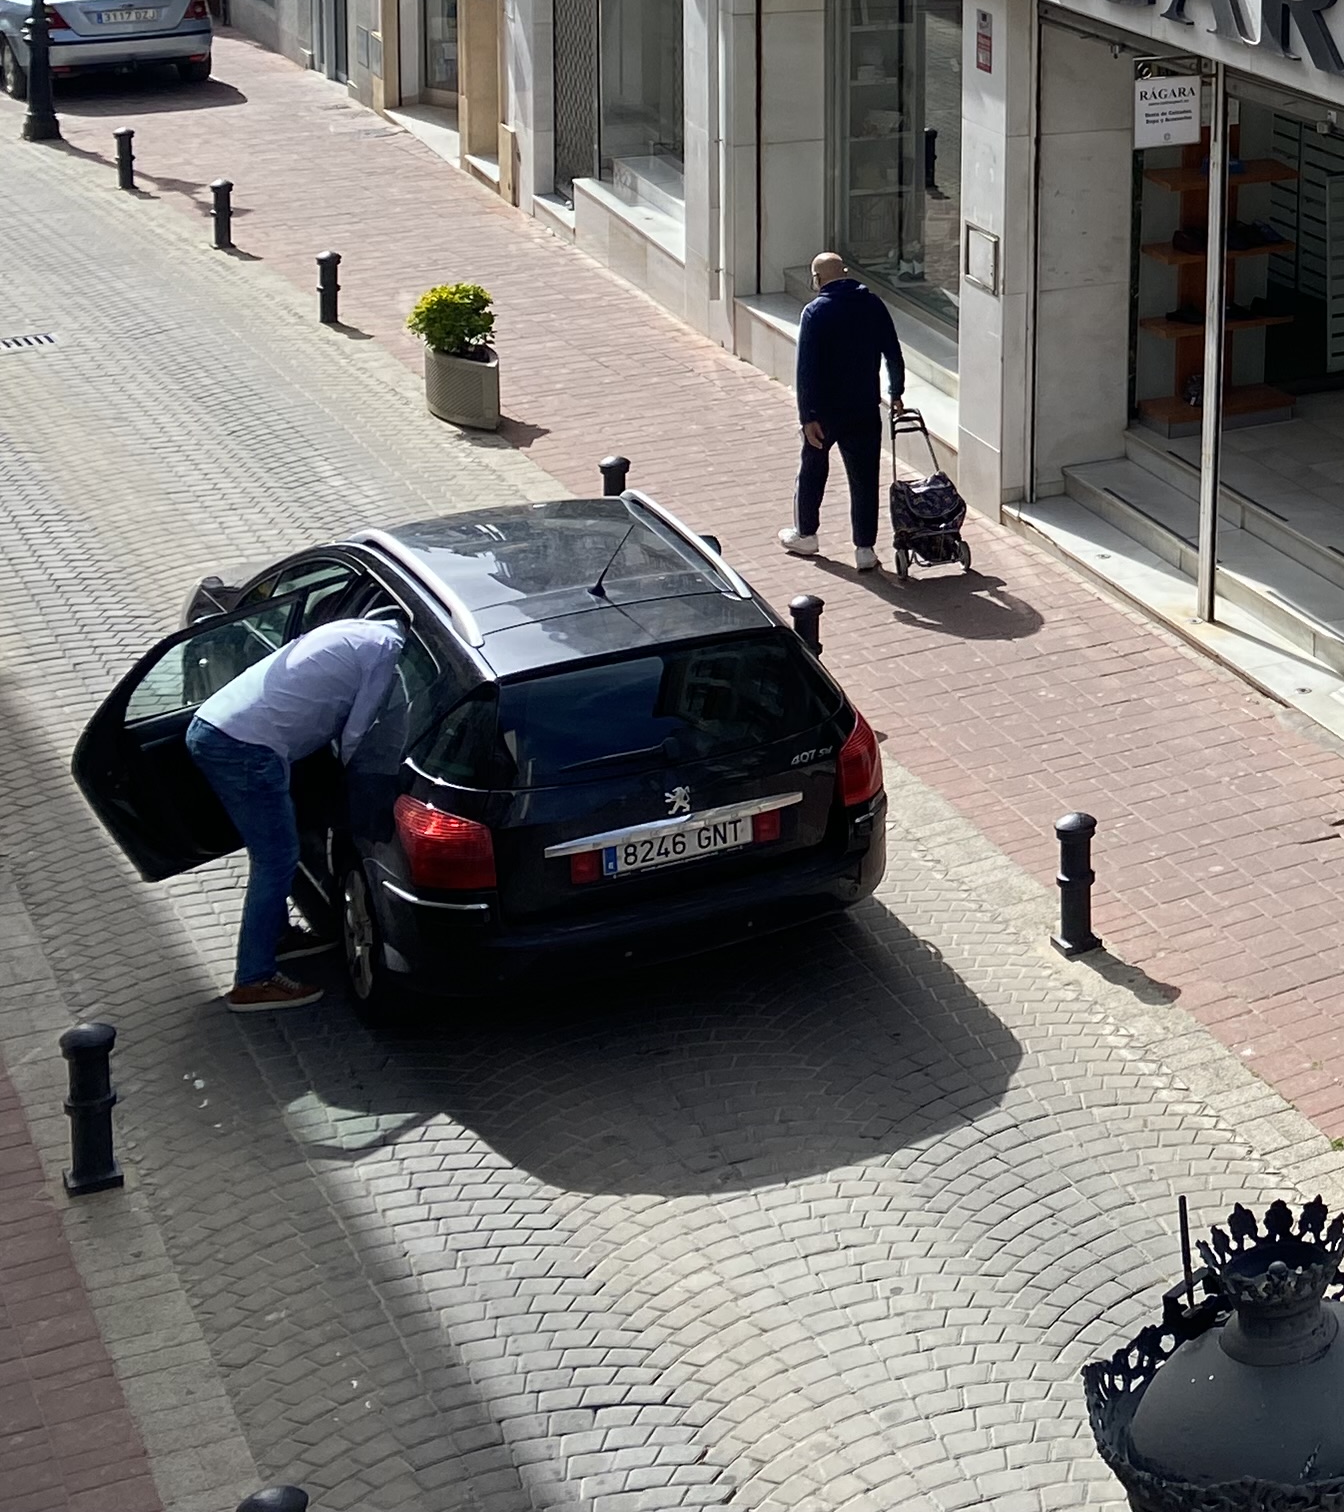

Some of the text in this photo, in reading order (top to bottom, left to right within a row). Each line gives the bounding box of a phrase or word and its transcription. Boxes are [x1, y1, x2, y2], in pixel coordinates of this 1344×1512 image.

[1140, 87, 1195, 101] RÁGARA
[791, 749, 816, 766] 407
[623, 832, 686, 866] 8246
[697, 819, 742, 849] GNT
